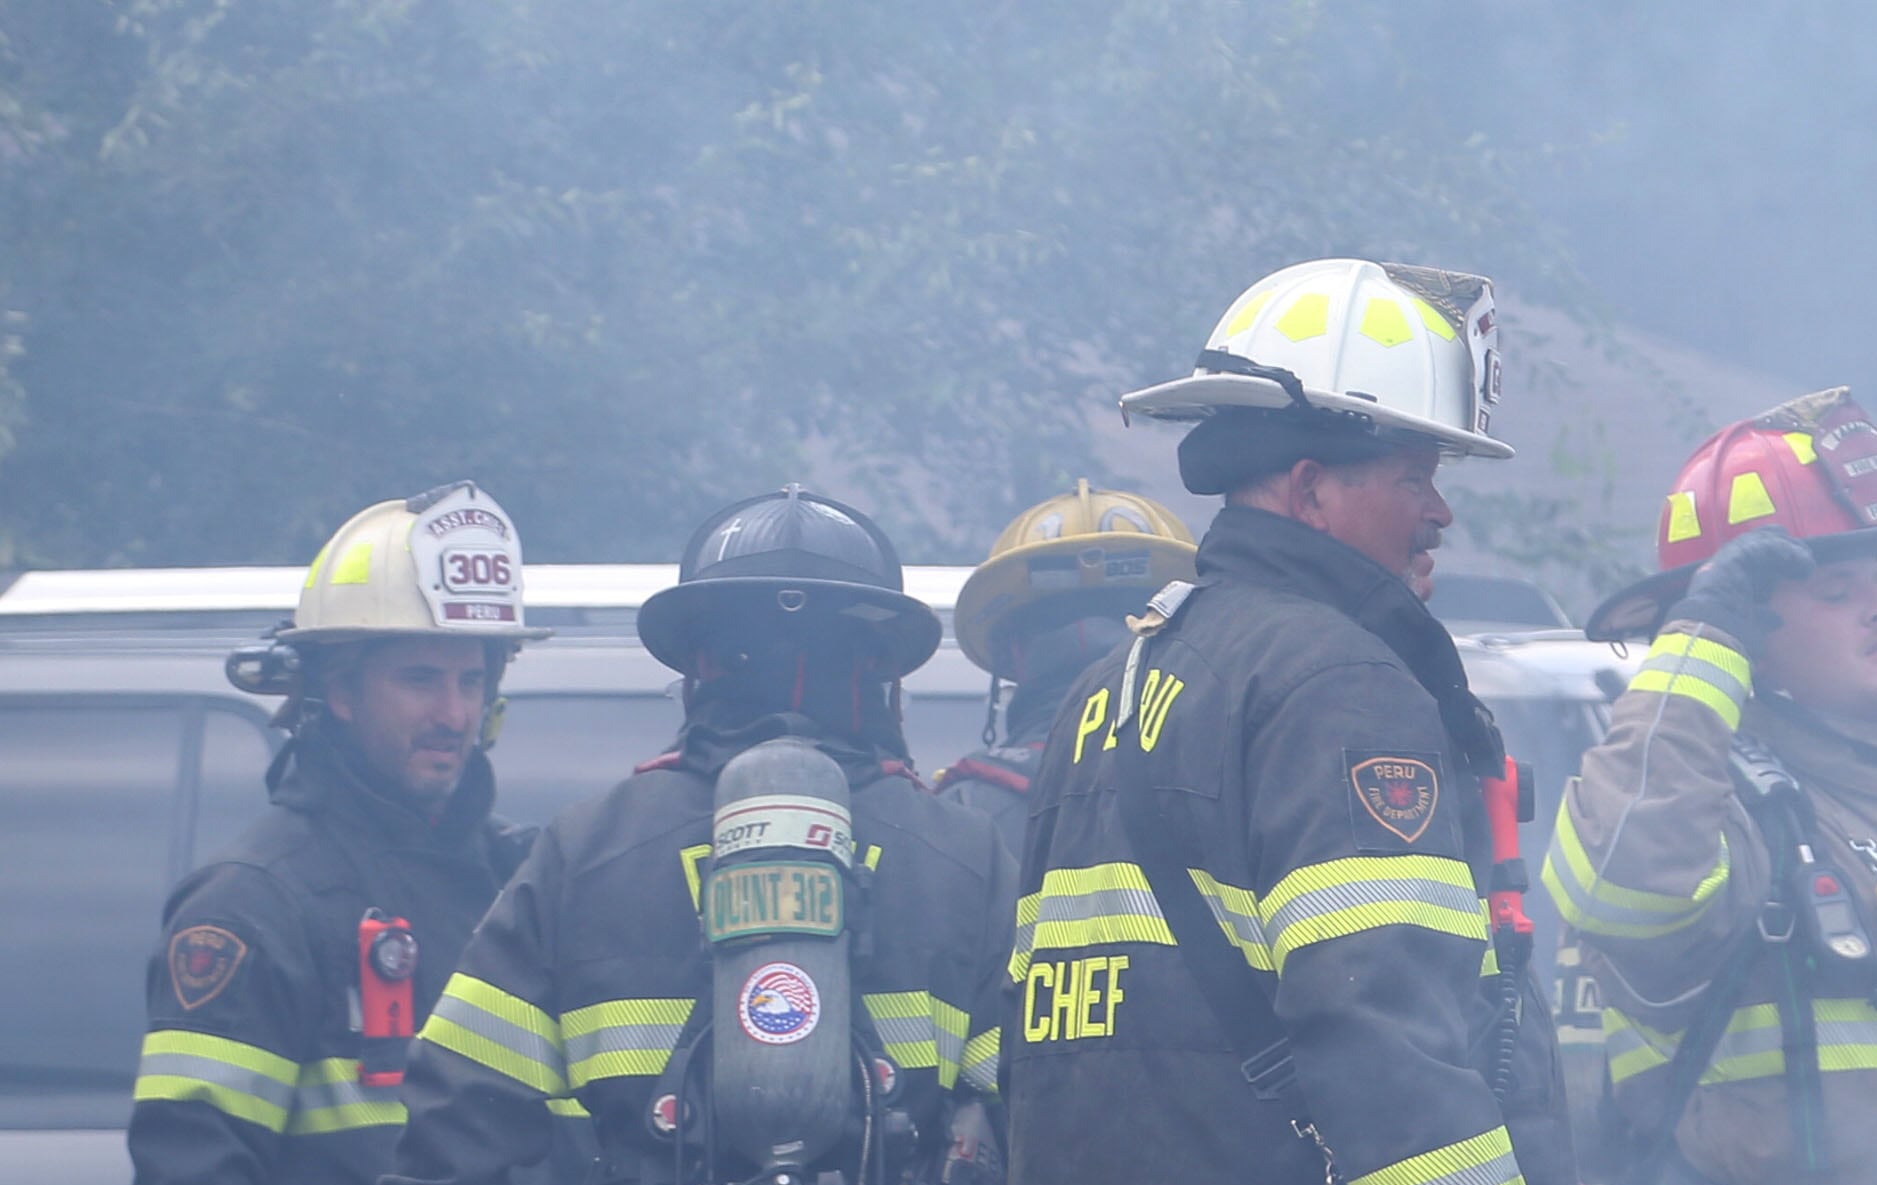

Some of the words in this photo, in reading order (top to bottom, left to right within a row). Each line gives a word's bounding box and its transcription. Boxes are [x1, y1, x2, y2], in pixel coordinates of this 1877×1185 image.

[449, 554, 511, 585] 306
[465, 604, 501, 619] PERU
[1373, 765, 1416, 779] PERU
[717, 822, 771, 848] SCOTT
[792, 872, 833, 923] 312
